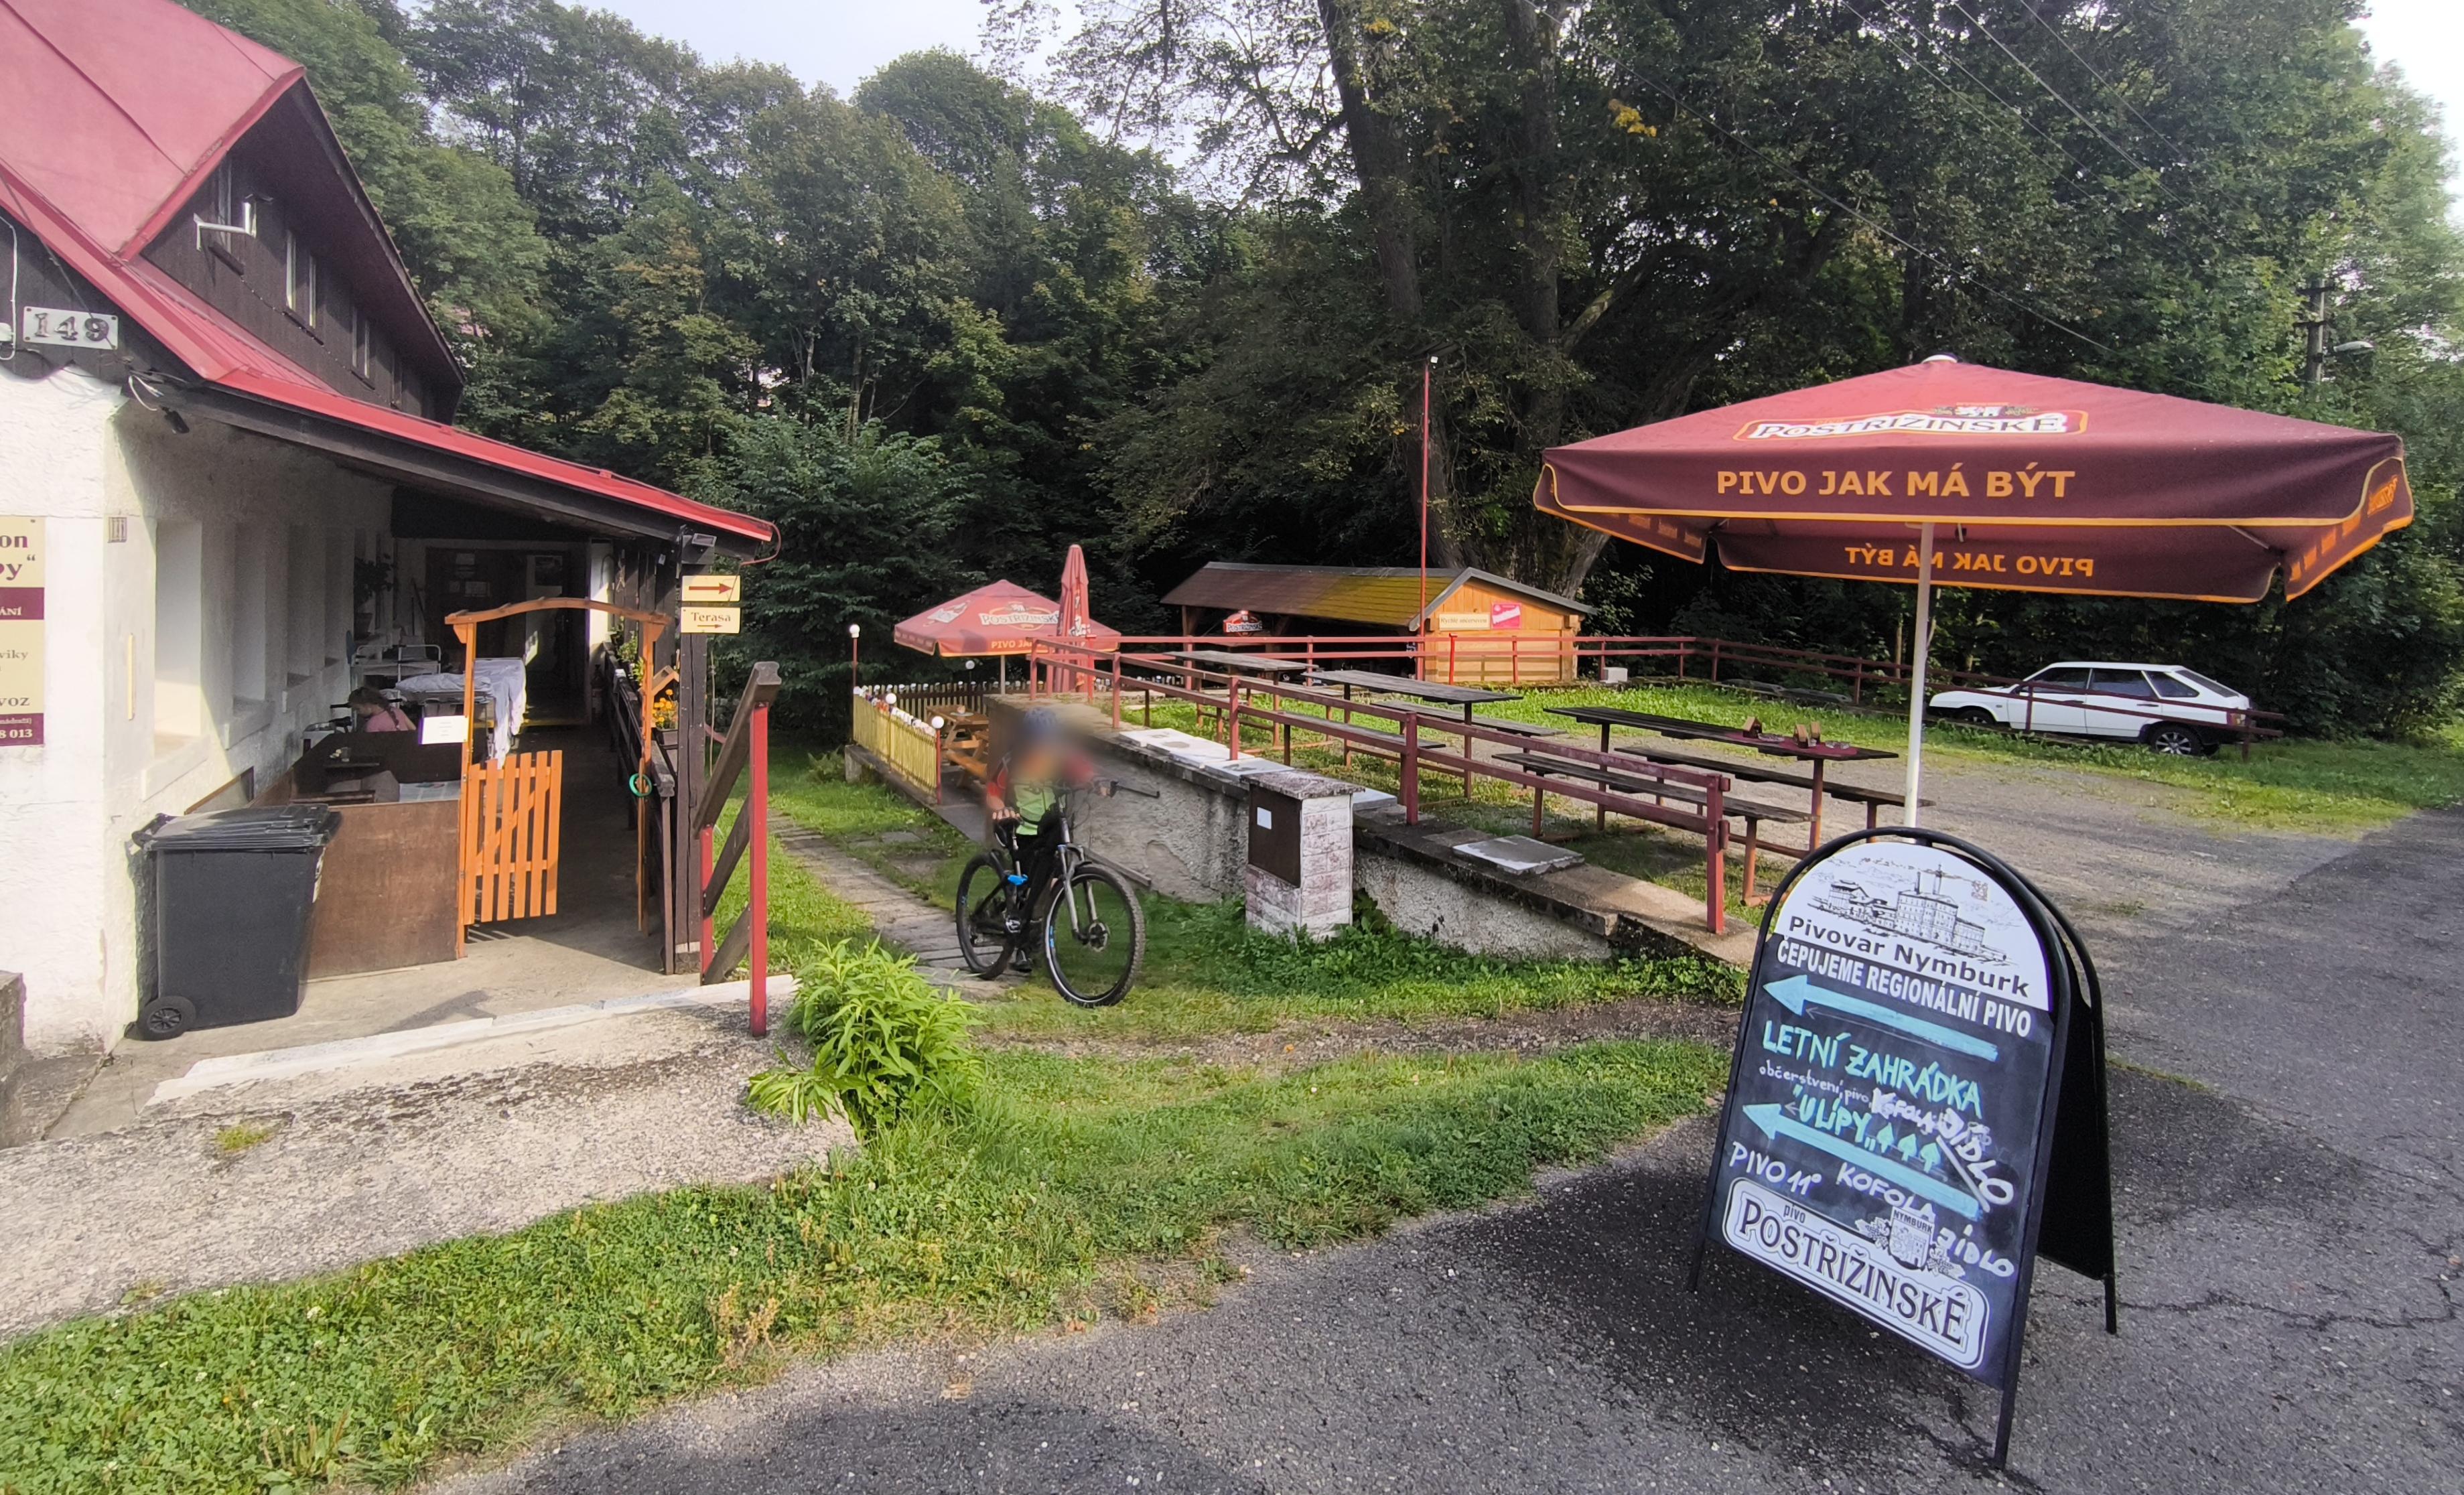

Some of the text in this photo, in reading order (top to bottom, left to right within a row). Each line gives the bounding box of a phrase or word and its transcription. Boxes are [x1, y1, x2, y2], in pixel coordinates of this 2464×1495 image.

[34, 312, 109, 342] 149
[1717, 462, 2076, 498] PIVO JAK MÁ BÝT
[691, 612, 731, 622] Terasa
[9, 729, 33, 738] 013
[1789, 916, 2030, 998] Pivovar Nymburk
[1777, 934, 2031, 1038] ČEPUJEME REGIONÁLNÍ PIVO
[1763, 1020, 1982, 1119] LETNÍ ZAHRÁDKA
[1729, 1141, 1787, 1183] PIVO
[1836, 1162, 1935, 1223] KOFOLA
[1783, 1204, 1806, 1223] pivo
[1893, 1210, 1933, 1233] NYMBURK
[1738, 1198, 1966, 1345] POSTŘIŽINSKÉ
